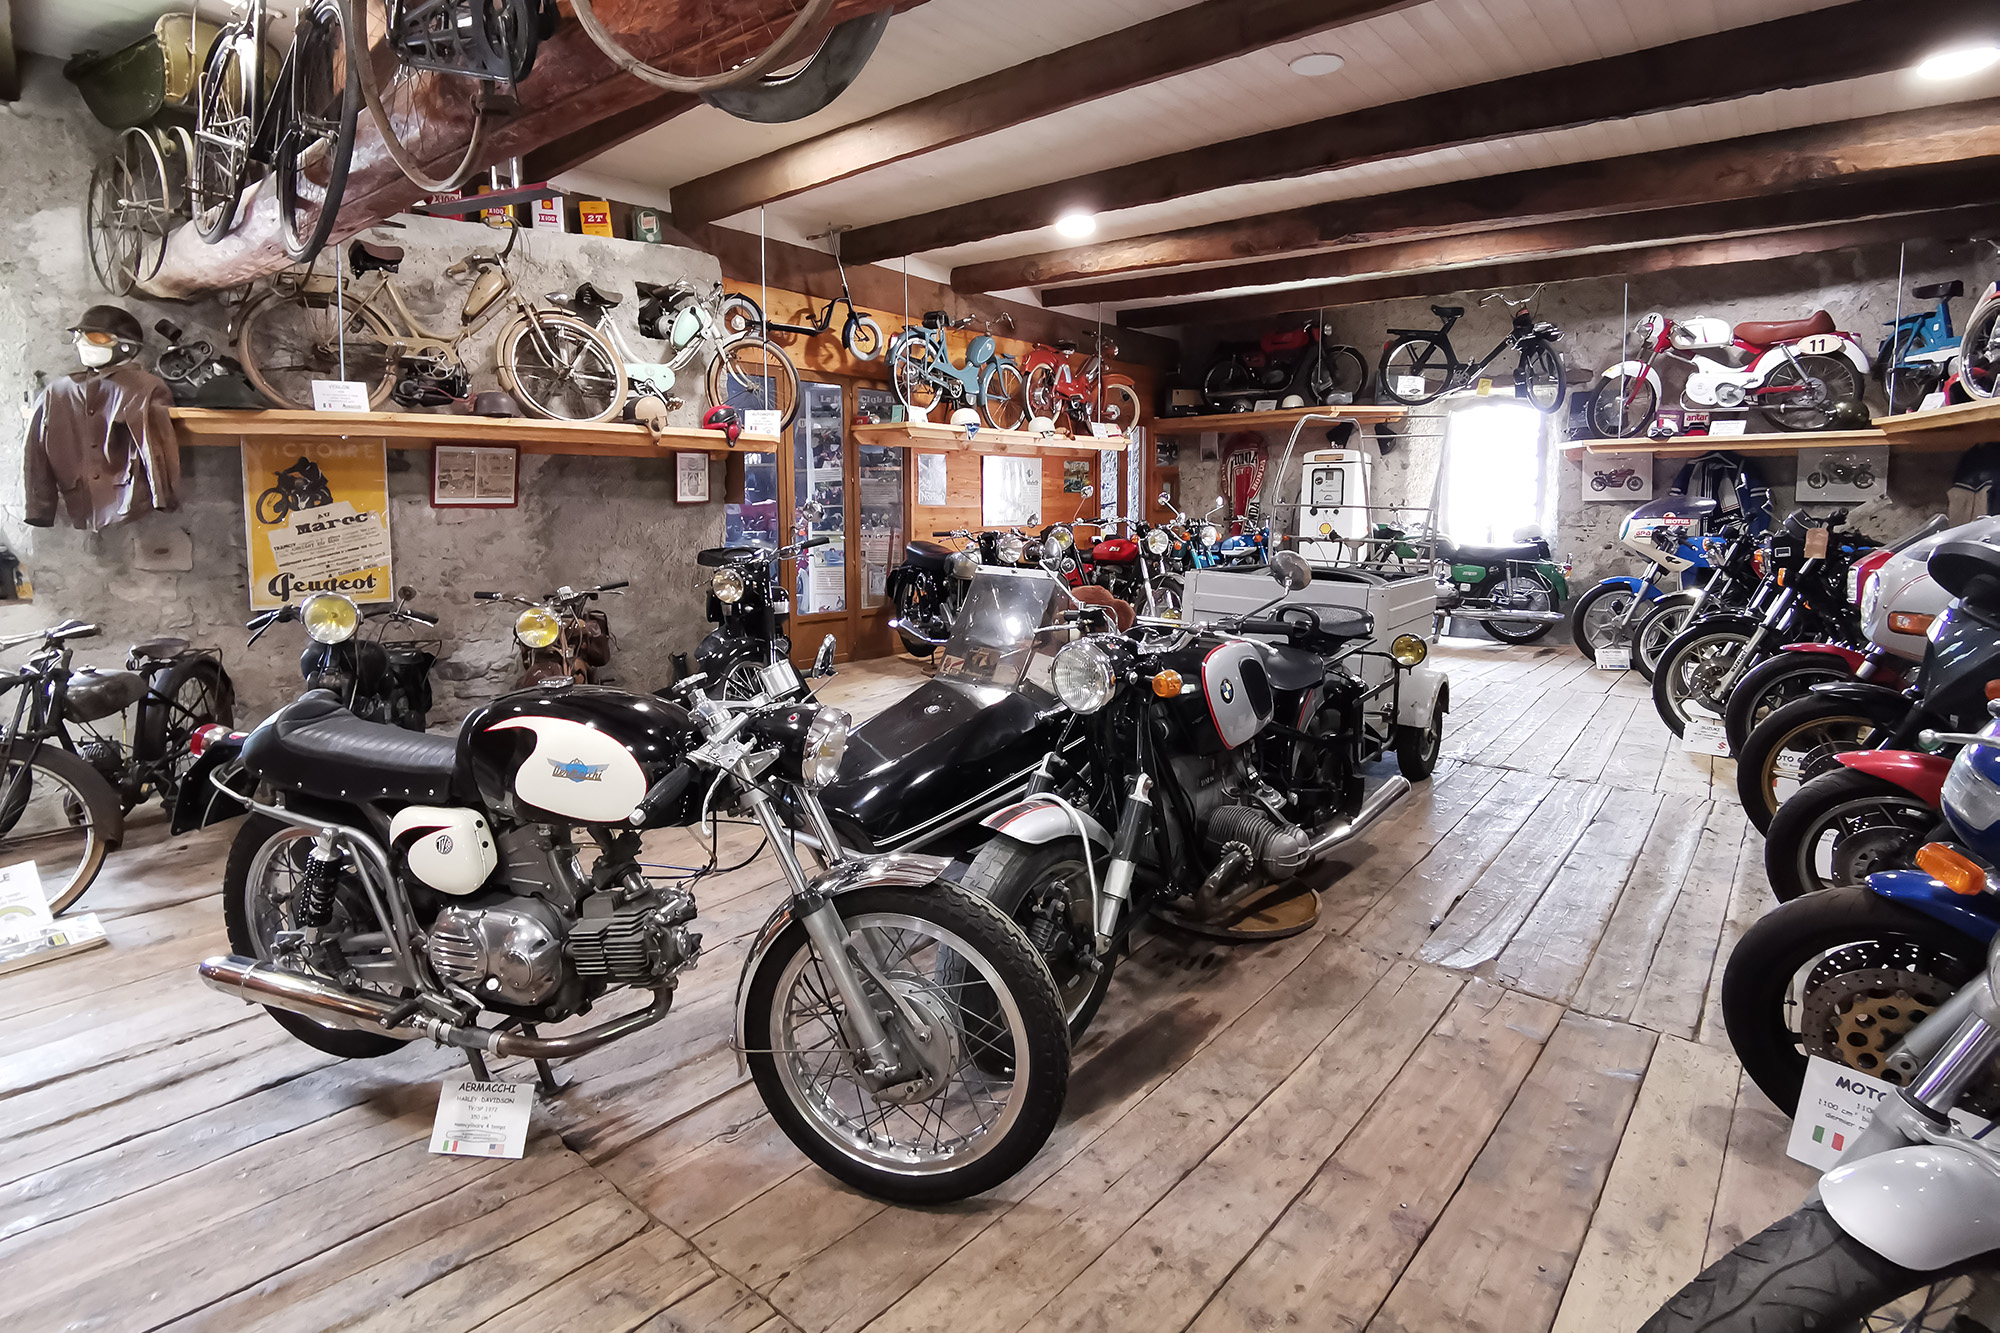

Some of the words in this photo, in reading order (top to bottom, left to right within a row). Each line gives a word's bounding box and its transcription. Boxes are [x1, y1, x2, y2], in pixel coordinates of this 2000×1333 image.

[488, 207, 504, 216] X100
[540, 213, 557, 223] X100
[587, 214, 603, 223] 2T
[1809, 338, 1826, 353] 11
[1686, 413, 1709, 422] antar
[245, 443, 377, 459] VICTOIRE
[1252, 459, 1267, 492] HONDA
[317, 511, 331, 520] AU
[295, 512, 368, 536] Maroc
[1664, 518, 1691, 526] MOTUL
[268, 572, 377, 602] Peugeot
[1730, 650, 1749, 673] SUZUKI
[1776, 755, 1794, 763] OTO
[458, 1082, 517, 1094] AERMACCHI
[481, 1096, 515, 1104] DAVIDSON
